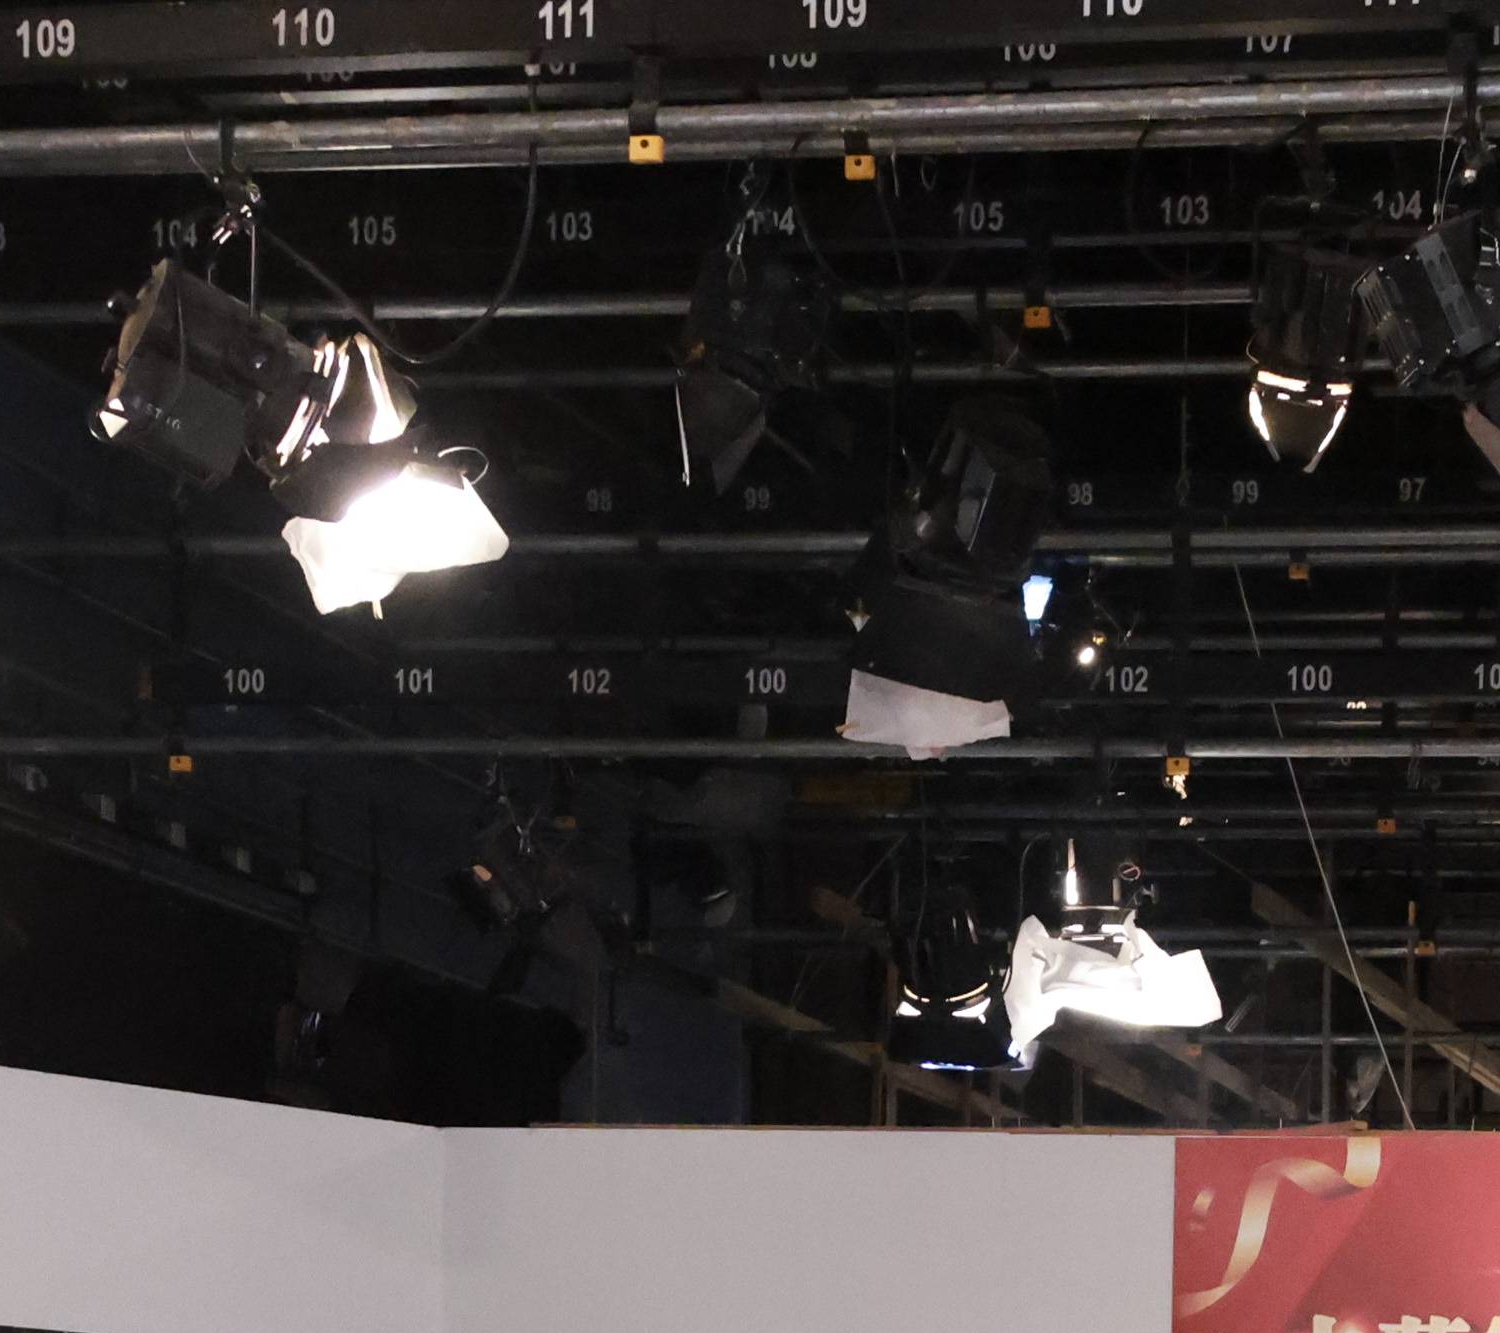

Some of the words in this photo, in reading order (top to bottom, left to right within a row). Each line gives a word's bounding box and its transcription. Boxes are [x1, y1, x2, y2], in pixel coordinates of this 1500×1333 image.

[272, 7, 335, 47] 110
[538, 0, 594, 40] 111
[802, 0, 867, 29] 109
[16, 18, 76, 58] 109
[953, 201, 1004, 232] 105
[1160, 194, 1210, 225] 103
[1372, 189, 1423, 220] 104
[153, 219, 198, 248] 104
[348, 215, 397, 246] 105
[546, 211, 593, 241] 103
[1068, 481, 1094, 506] 98
[1232, 479, 1259, 504] 99
[1399, 477, 1426, 502] 97
[224, 668, 265, 694] 100
[394, 668, 433, 694] 101
[568, 668, 611, 695] 102
[745, 667, 787, 694] 100
[1105, 665, 1149, 693] 102
[1287, 664, 1333, 692] 100
